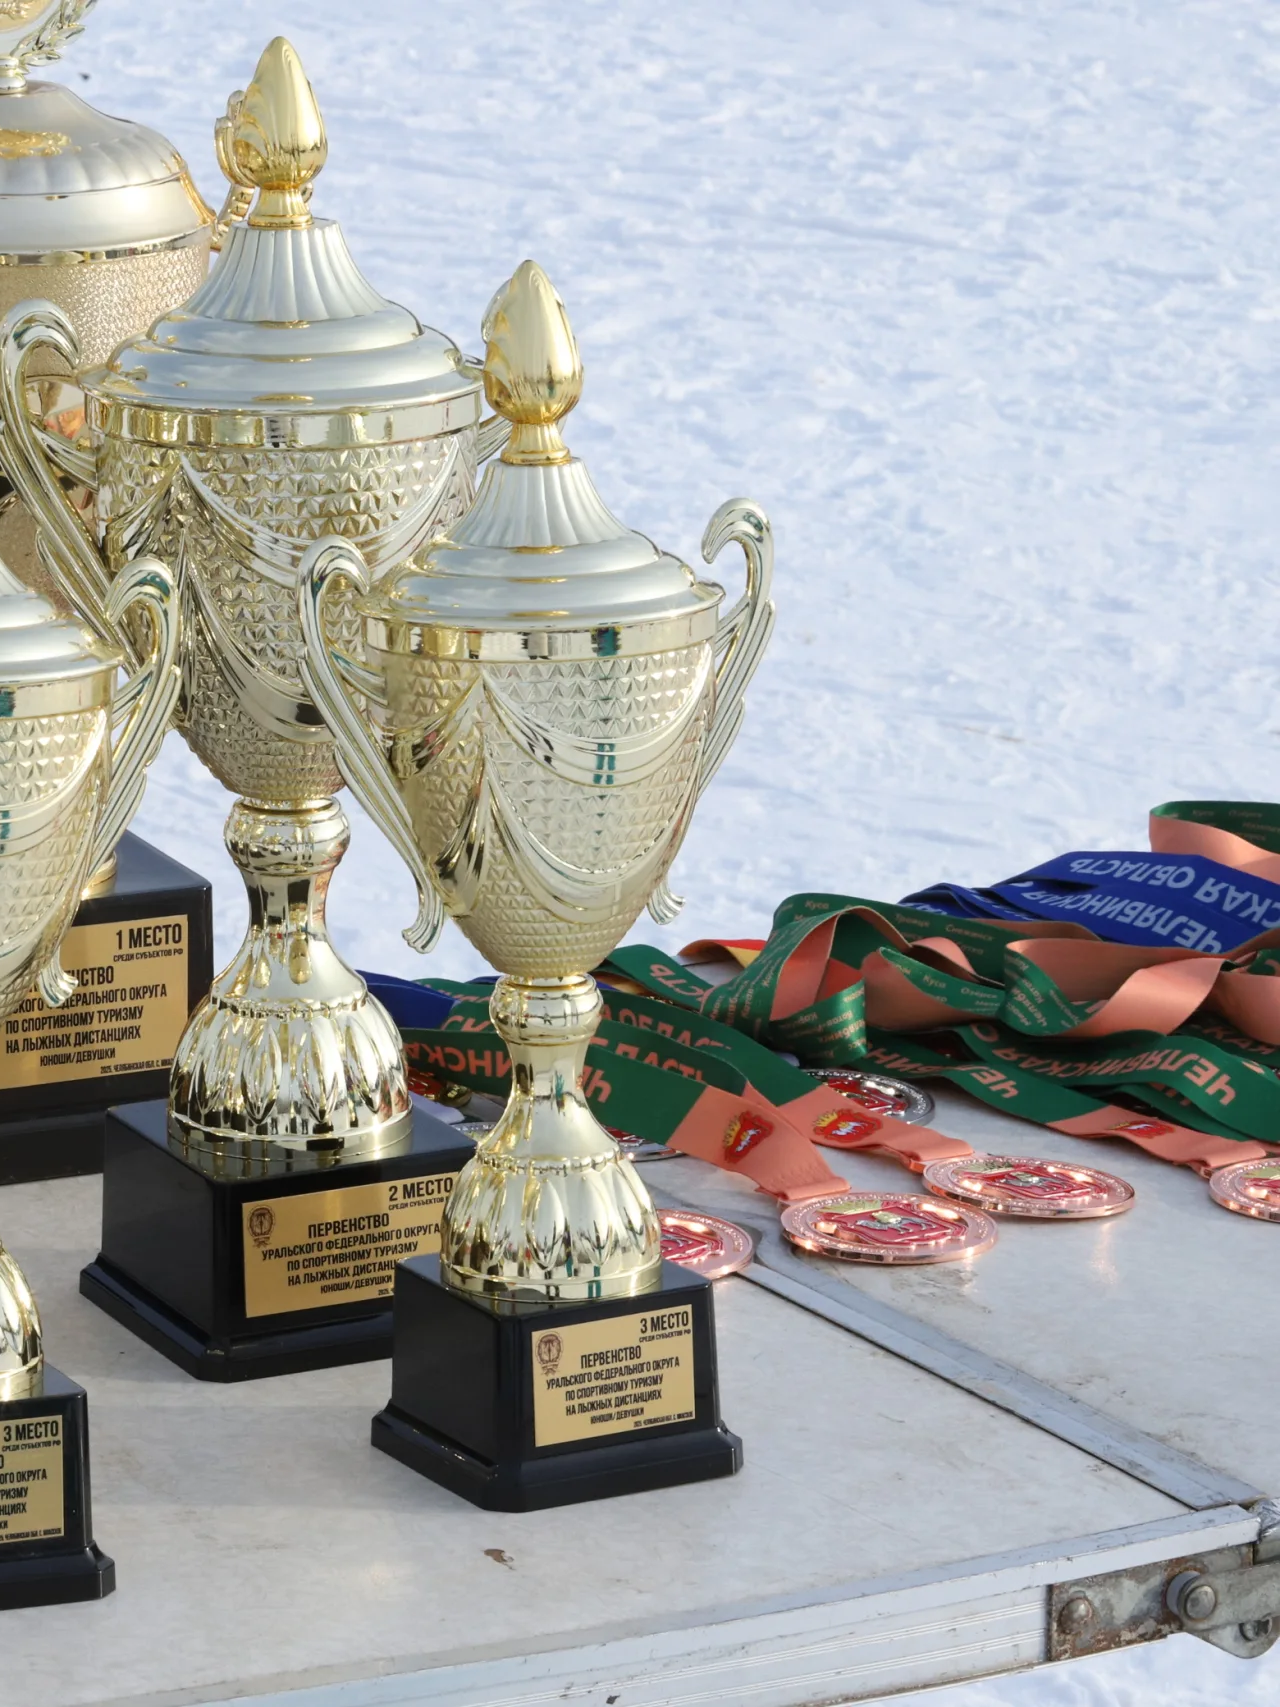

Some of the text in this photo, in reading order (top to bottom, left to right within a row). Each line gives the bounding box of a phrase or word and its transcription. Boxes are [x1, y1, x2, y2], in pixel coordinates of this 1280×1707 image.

[1070, 858, 1196, 889] ОБЛАСТЬ
[116, 923, 181, 949] 1 МЕСТО
[113, 954, 134, 962] СРЕДИ
[136, 949, 172, 960] СУБЪЕКТОВ
[129, 984, 167, 1000] ОКРУГА
[6, 1006, 143, 1034] ПО СПОРТИВНОМУ ТУРИЗМУ
[6, 1025, 141, 1054] НА ЛЫЖНЫХ ДИСТАНЦИЯХ
[40, 1048, 115, 1066] ЮНОШИ/ДЕВУШКИ
[992, 1049, 1237, 1105] ЧЕЛЯБИНСКАЯ
[389, 1177, 453, 1201] 2 МЕСТО
[388, 1203, 408, 1211] СРЕДИ
[410, 1197, 444, 1207] СУБЪЕКТОВ
[308, 1213, 389, 1239] ПЕРВЕНСТВО
[262, 1223, 440, 1261] УРАЛЬСКОГО ФЕДЕРАЛЬНОГО ОКРУГА
[287, 1241, 418, 1271] ПО СПОРТИВНОМУ ТУРИЗМУ
[288, 1274, 301, 1286] НА
[303, 1265, 350, 1284] ЛЫЖНЫХ
[321, 1275, 392, 1294] ЮНОШИ/ДЕВУШКИ
[640, 1311, 689, 1333] 3 МЕСТО
[581, 1345, 642, 1369] ПЕРВЕНСТВО
[546, 1356, 679, 1390] УРАЛЬСКОГО ФЕДЕРАЛЬНОГО ОКРУГА
[566, 1374, 663, 1401] ПО СПОРТИВНОМУ ТУРИЗМУ
[566, 1389, 662, 1416] НА ЛЫЖНЫХ ДИСТАНЦИЯХ
[4, 1420, 58, 1442] 3 МЕСТО
[17, 1469, 47, 1483] ОКРУГА
